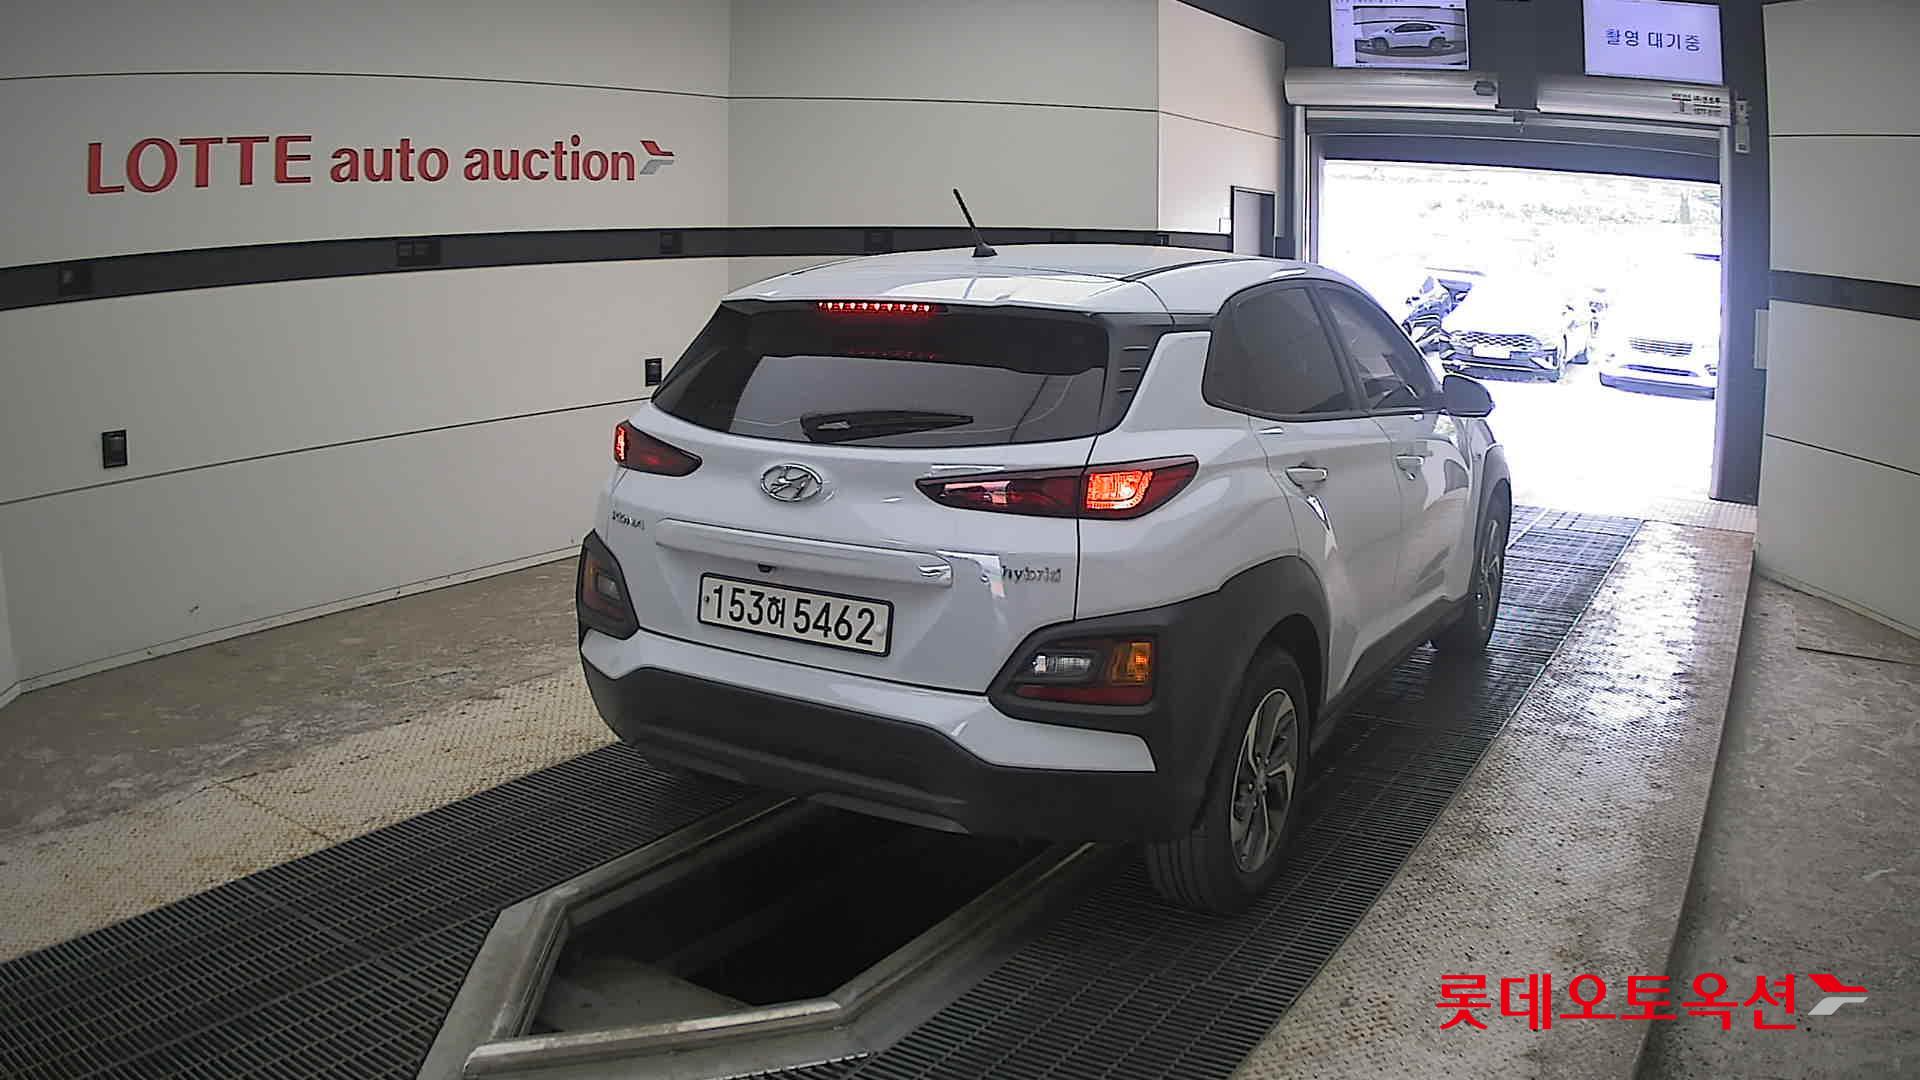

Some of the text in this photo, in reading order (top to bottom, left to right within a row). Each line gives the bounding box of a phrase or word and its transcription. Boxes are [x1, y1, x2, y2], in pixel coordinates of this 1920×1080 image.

[87, 134, 636, 195] LOTTE auto auction
[1001, 565, 1061, 585] hybrid
[793, 598, 876, 646] 5462
